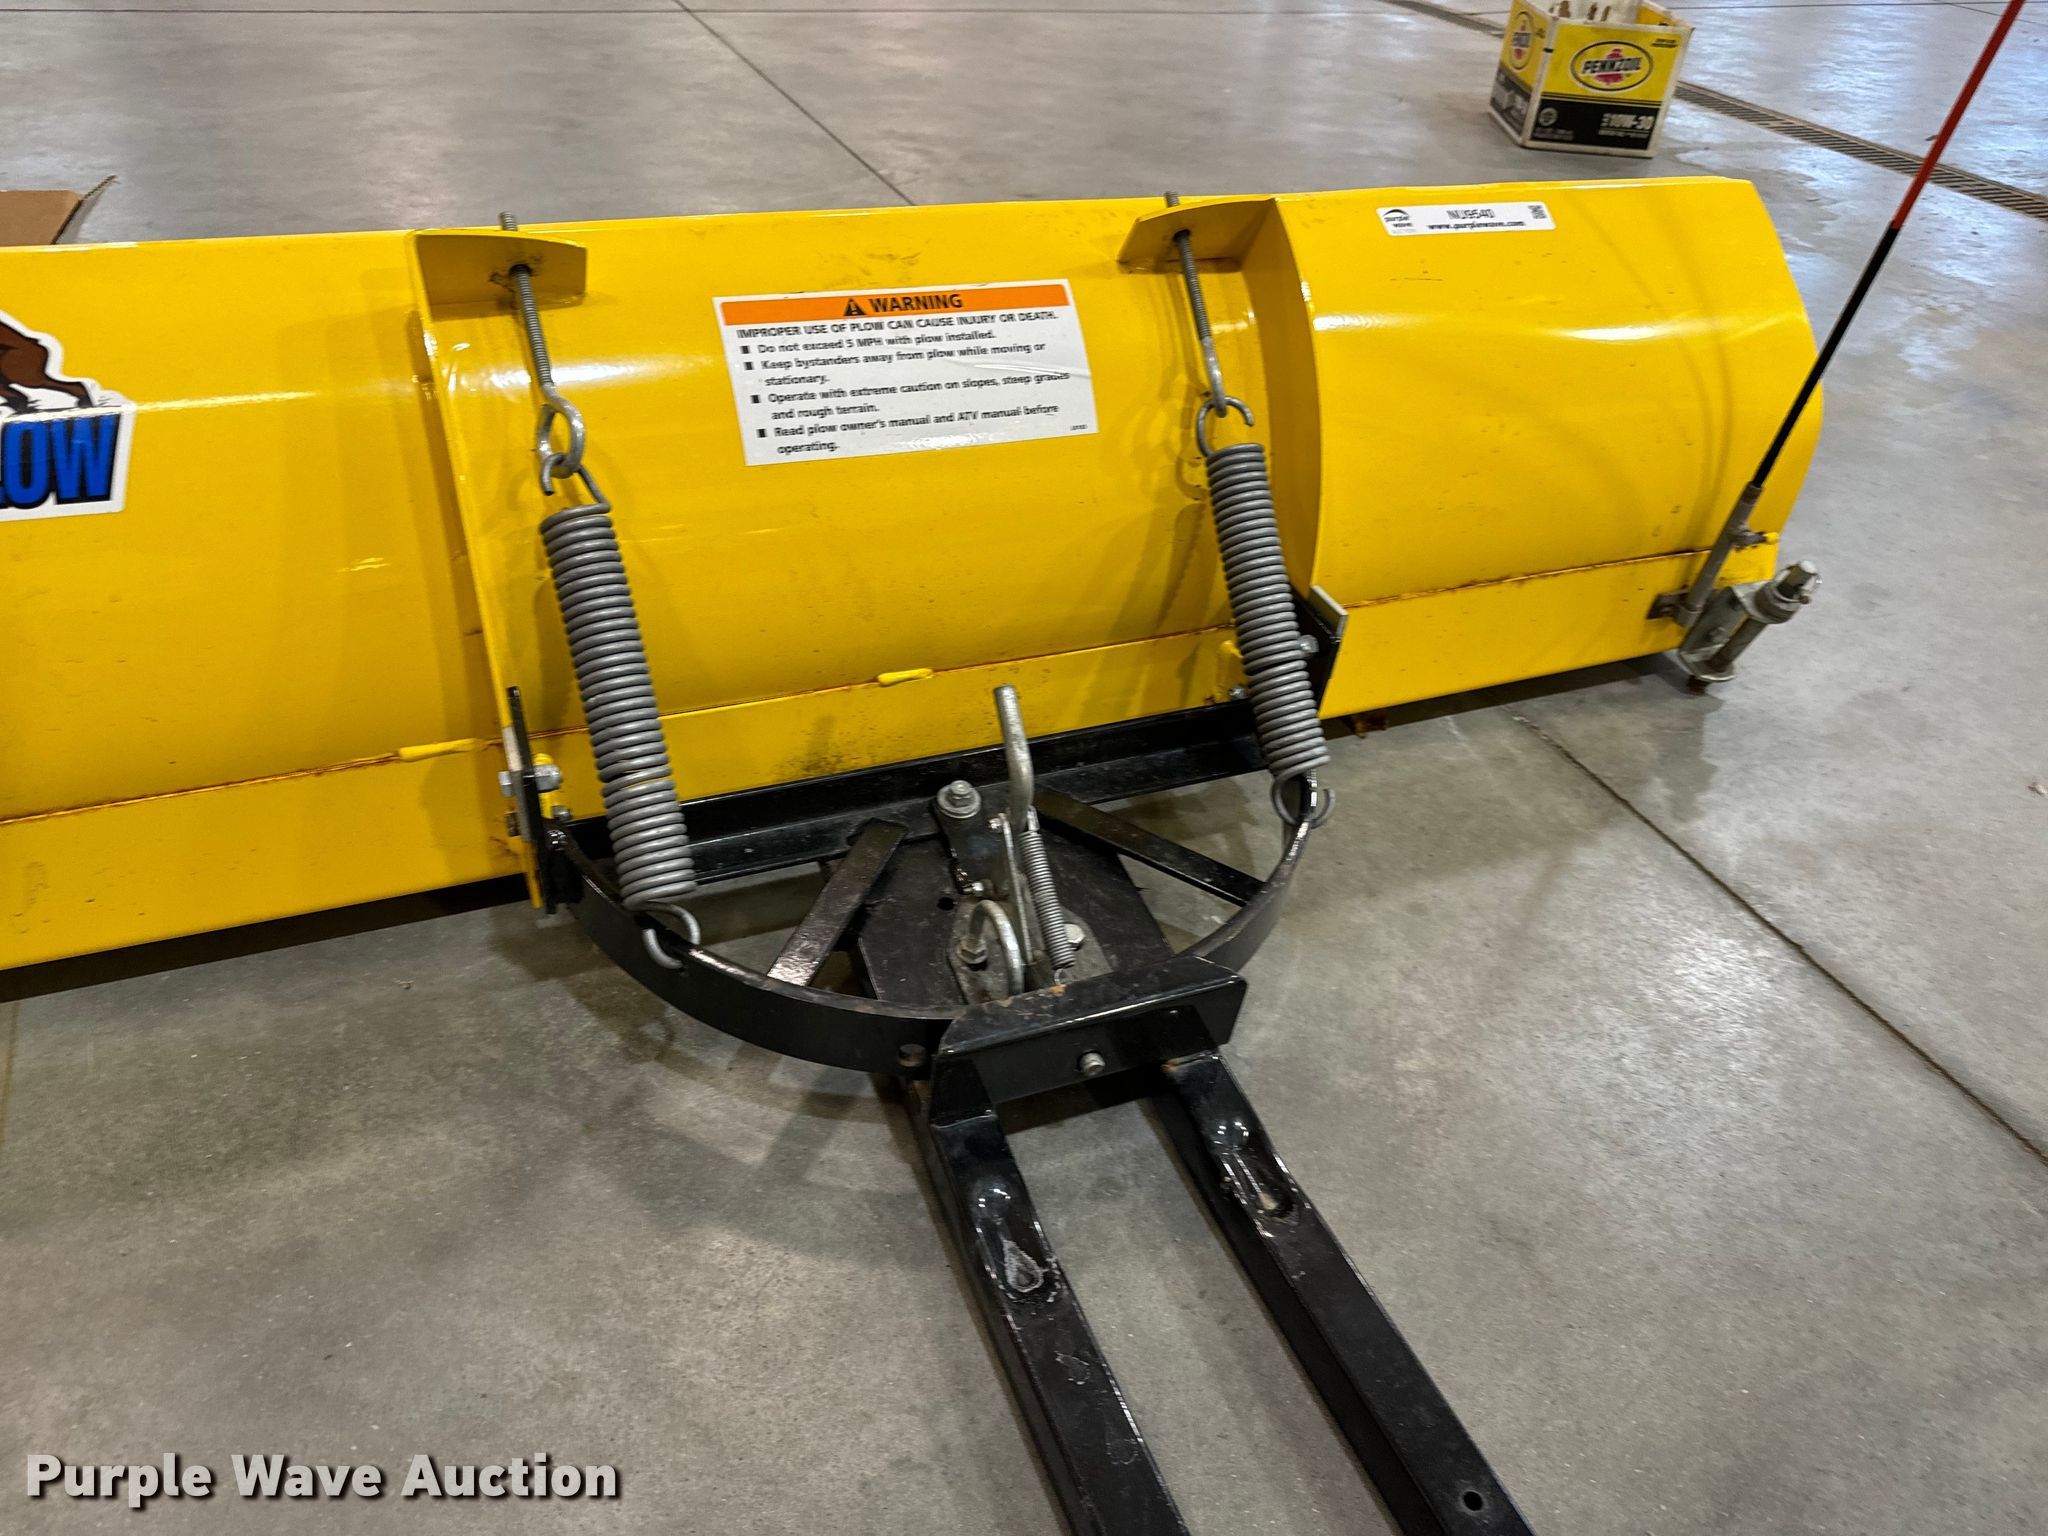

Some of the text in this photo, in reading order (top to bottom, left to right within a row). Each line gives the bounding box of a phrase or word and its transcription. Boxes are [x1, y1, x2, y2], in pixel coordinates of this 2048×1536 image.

[1581, 57, 1642, 74] PENNZOIL
[1428, 221, 1525, 230] www.purplewave.com
[869, 293, 963, 313] WARNING
[736, 310, 1059, 338] IMPROPER USE OF PLOW CAN CAUSE INJURY OR DEATH.
[757, 330, 997, 354] Do not exceed 5 MPH with plow installed.
[761, 343, 1046, 371] Keep bystanders away from plow while moving or
[764, 374, 830, 386] stationary.
[767, 372, 1070, 404] Operate with extreme caution on slopes, steep grades
[771, 402, 880, 420] and rough terrain.
[773, 404, 1059, 437] Read plow owner's manual and ATV manual before
[776, 440, 840, 455] operating.
[0, 413, 121, 509] OW
